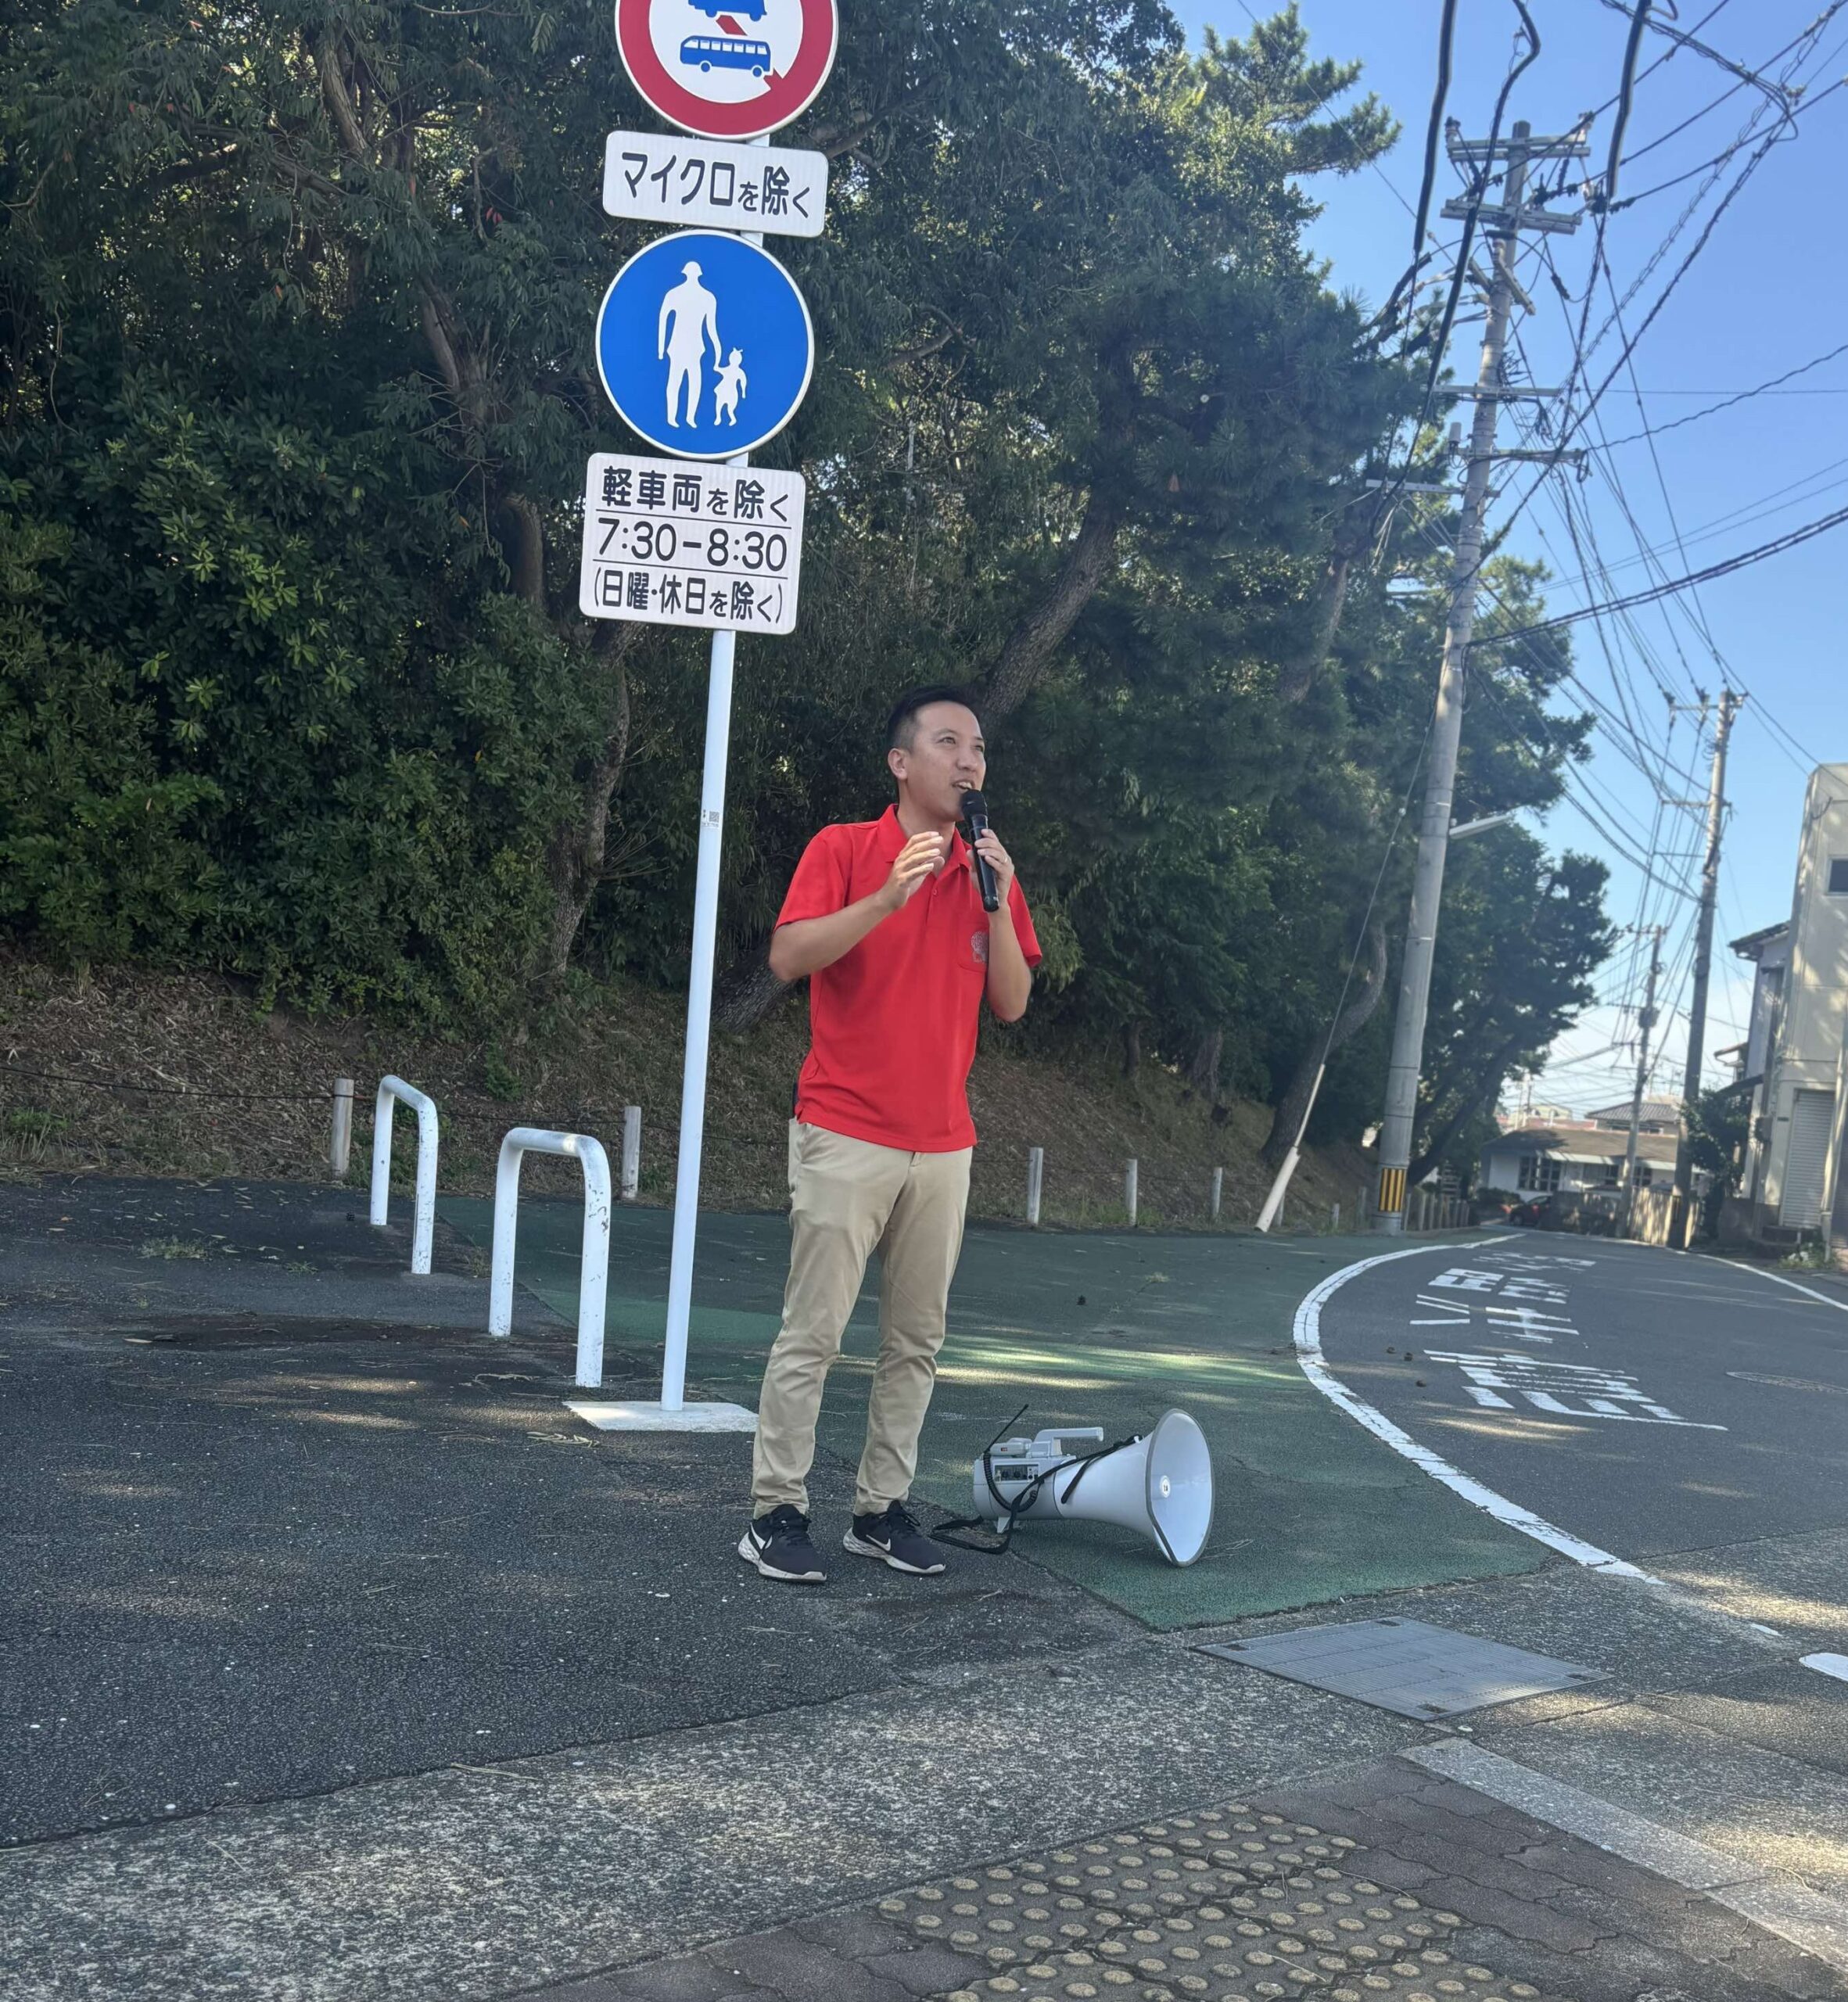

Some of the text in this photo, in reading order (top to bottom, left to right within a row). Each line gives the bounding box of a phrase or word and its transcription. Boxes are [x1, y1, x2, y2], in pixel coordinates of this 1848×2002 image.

[621, 152, 810, 218] マイクロを除く
[601, 465, 789, 522] 軽車両を除く
